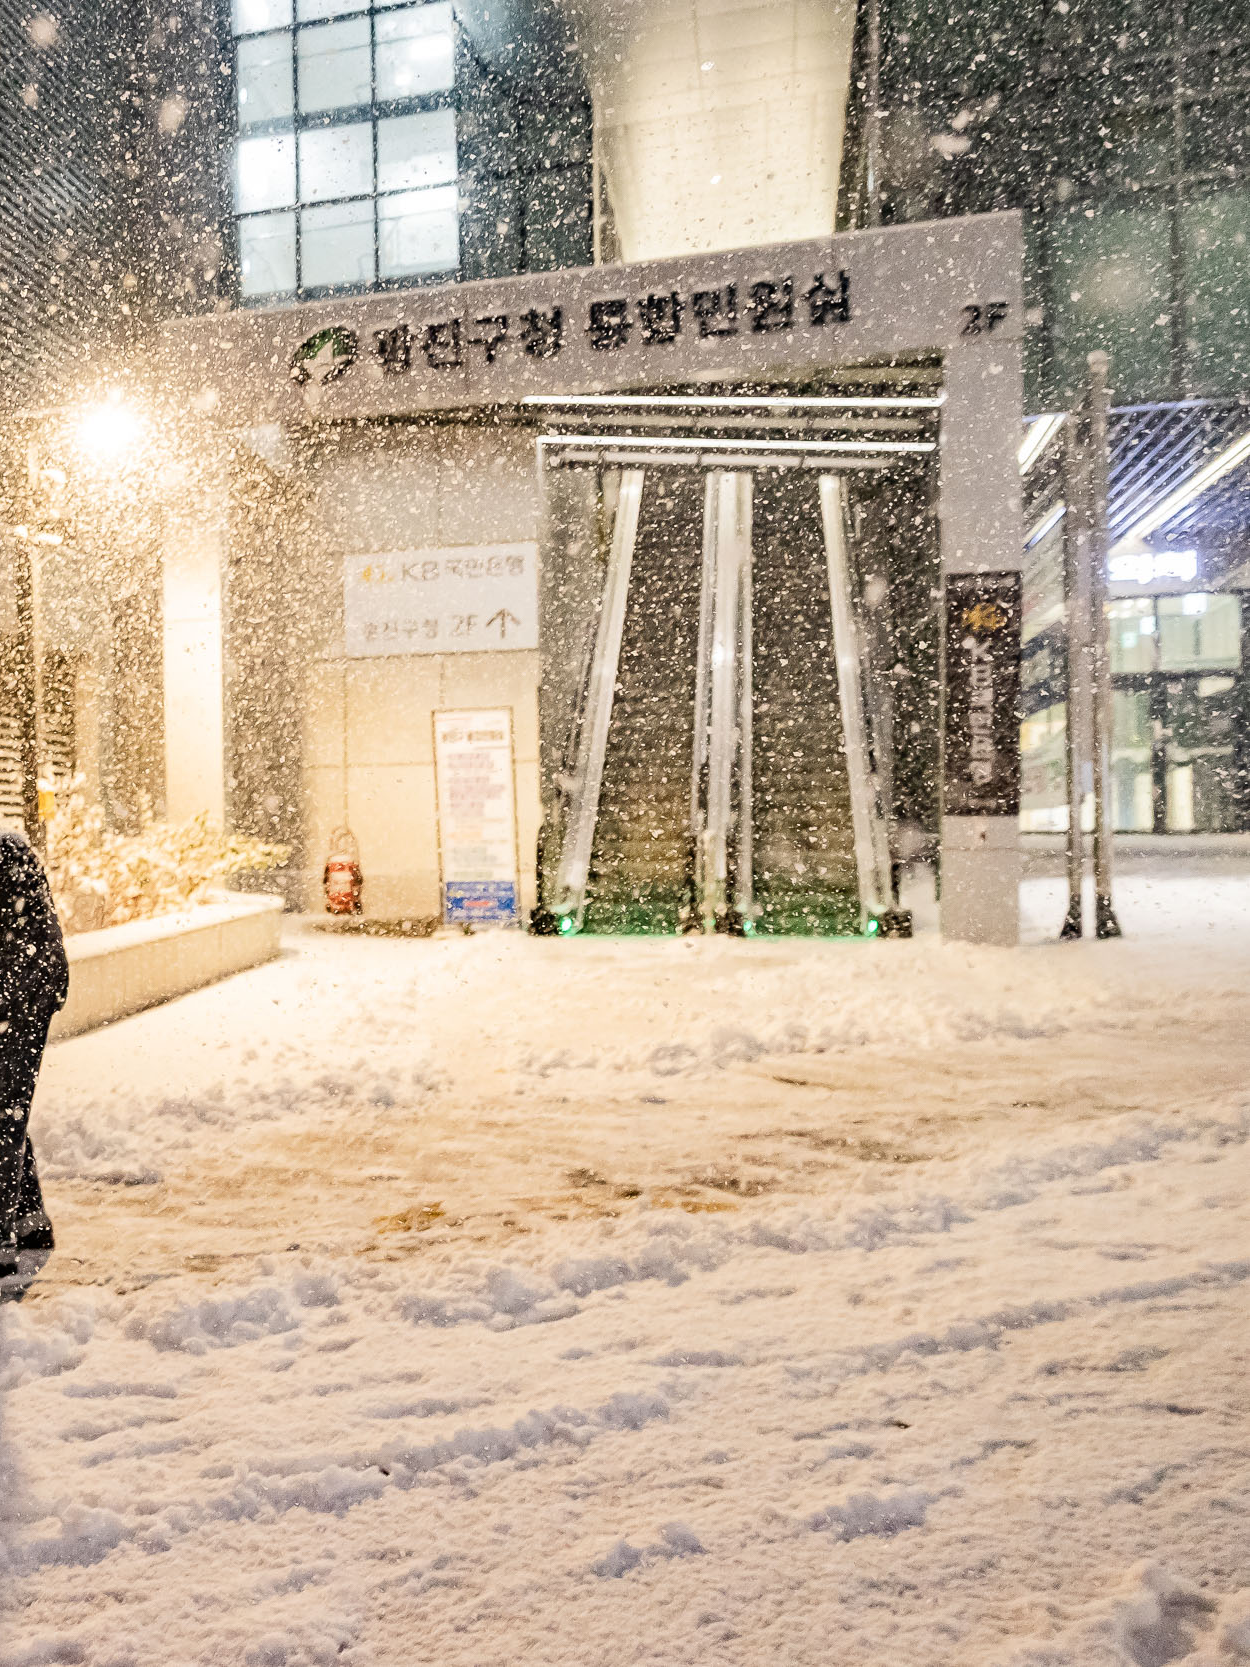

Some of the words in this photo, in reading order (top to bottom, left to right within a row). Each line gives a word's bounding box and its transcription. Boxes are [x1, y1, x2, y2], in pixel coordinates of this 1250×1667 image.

[959, 301, 1010, 335] 2F
[401, 560, 440, 582] KB
[445, 555, 525, 579] 국민은행
[449, 614, 479, 638] 2F
